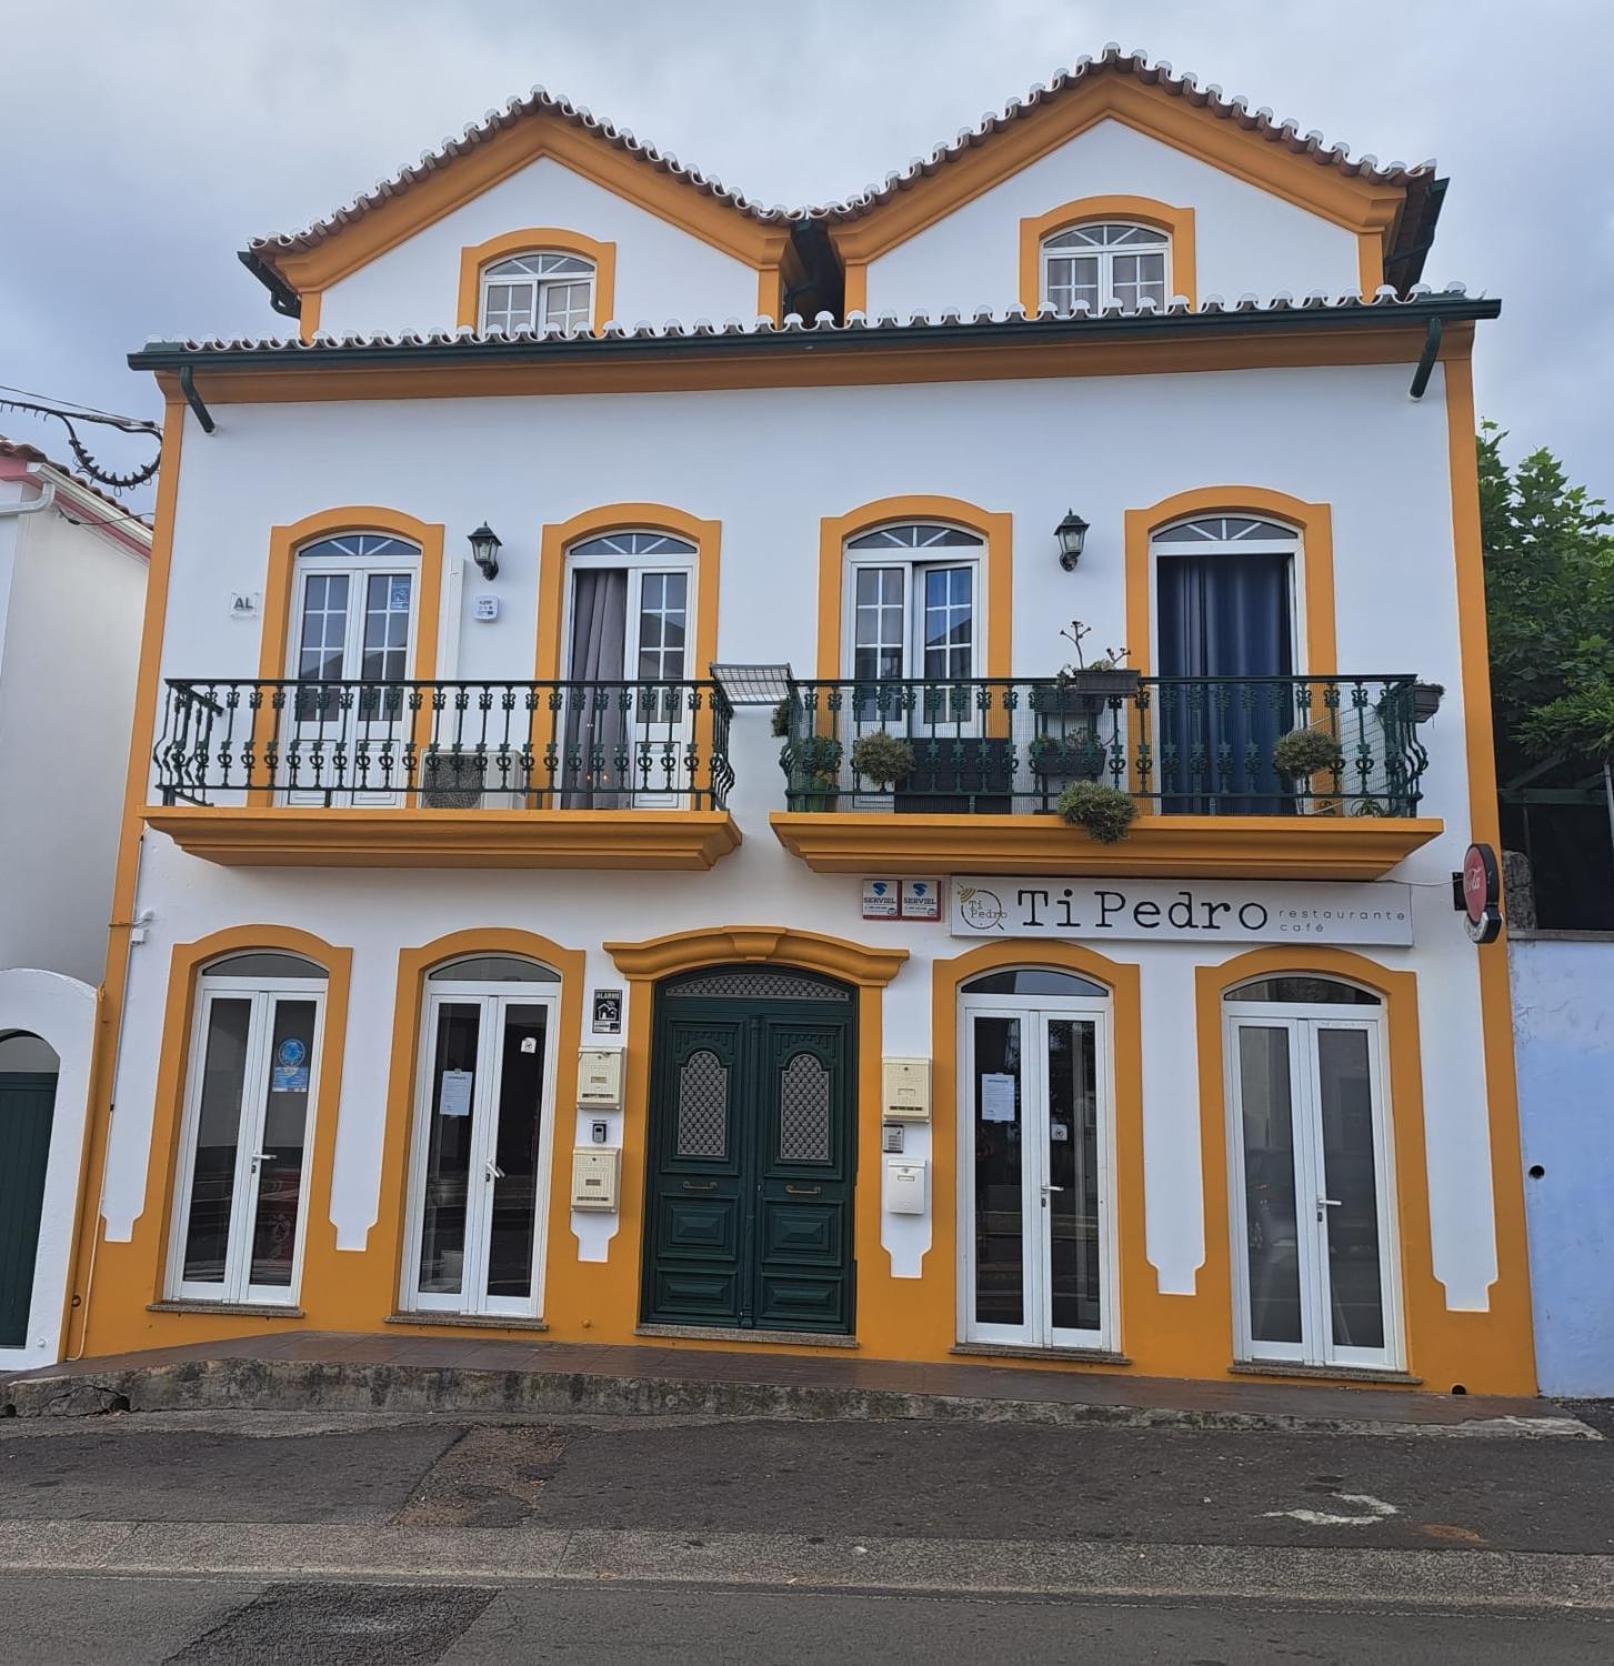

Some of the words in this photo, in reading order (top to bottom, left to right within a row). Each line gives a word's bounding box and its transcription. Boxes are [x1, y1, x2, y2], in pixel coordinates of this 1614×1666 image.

[233, 596, 254, 609] AL
[971, 908, 1008, 918] Pedro
[1018, 889, 1081, 927] Ti
[1094, 891, 1268, 931] Pedro
[1279, 909, 1405, 921] restaurante
[1280, 922, 1324, 933] café
